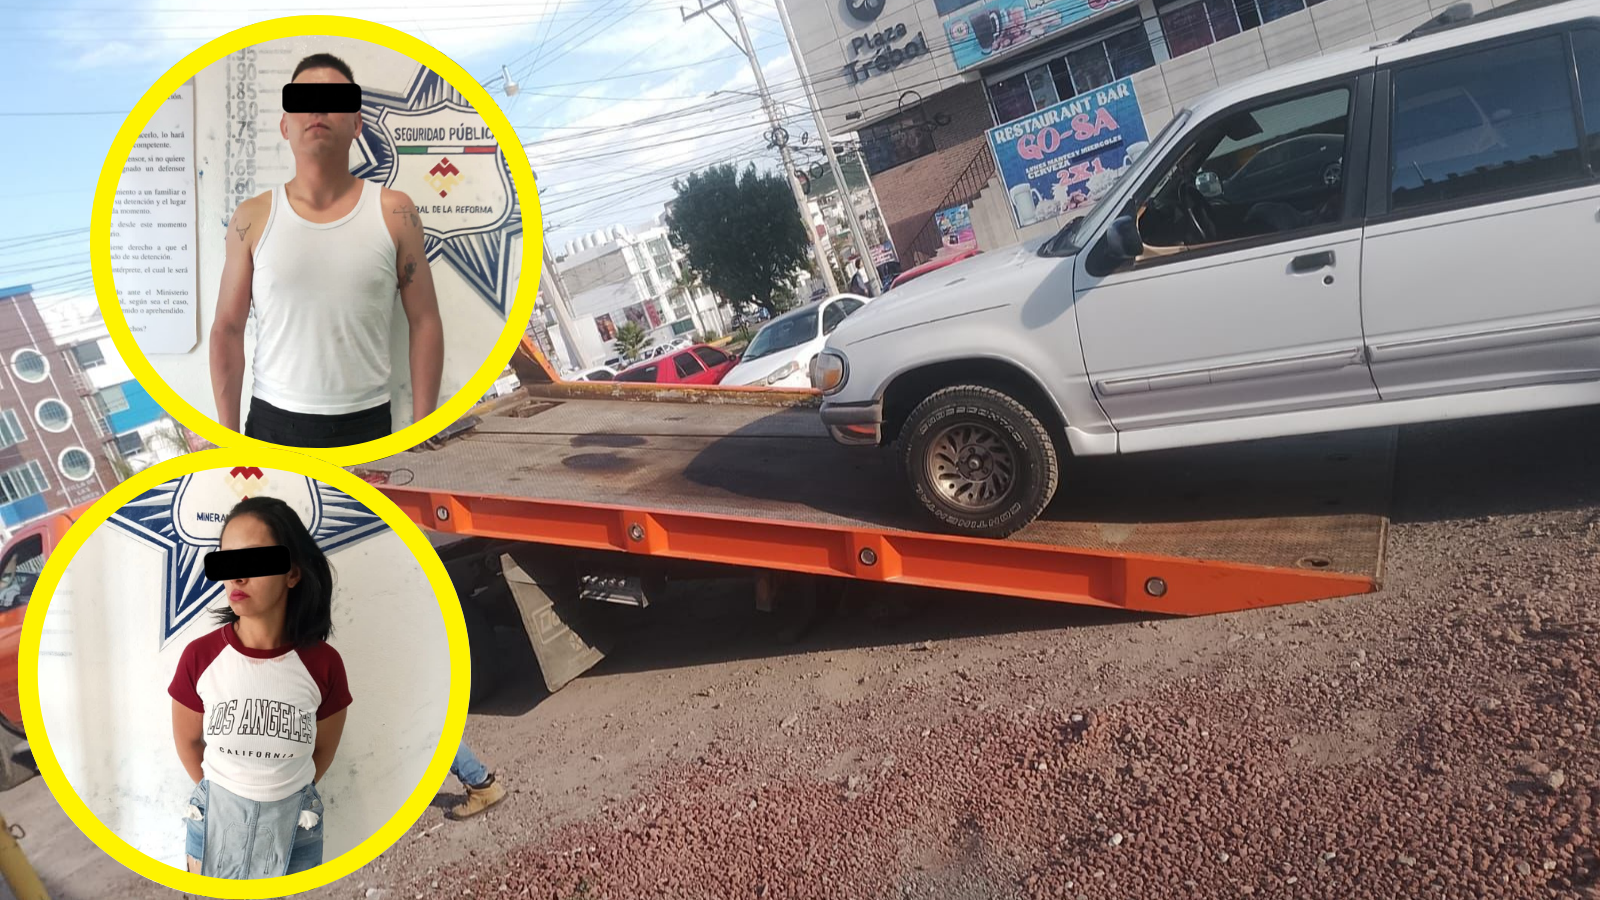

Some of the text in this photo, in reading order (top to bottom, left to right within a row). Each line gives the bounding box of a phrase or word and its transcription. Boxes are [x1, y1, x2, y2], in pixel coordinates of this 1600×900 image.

[851, 23, 907, 55] Plaza
[844, 31, 929, 84] Trébol
[226, 62, 257, 81] 1.90
[225, 82, 257, 100] 1.85
[225, 100, 258, 120] 1.80
[994, 83, 1130, 144] RESTAURANT BAR
[225, 120, 257, 139] 1.75
[394, 127, 445, 142] SEGURIDAD
[225, 139, 256, 158] 1.70
[165, 155, 185, 164] quiere
[224, 158, 256, 176] 1.65
[1028, 160, 1070, 179] CERVEZA
[1056, 157, 1106, 186] 2X1
[170, 198, 186, 207] lugar
[432, 205, 441, 214] DE
[443, 205, 453, 214] LA
[455, 205, 493, 214] REFORMA
[207, 699, 312, 744] LOS ANGELES
[219, 746, 294, 759] CALIFORNIA
